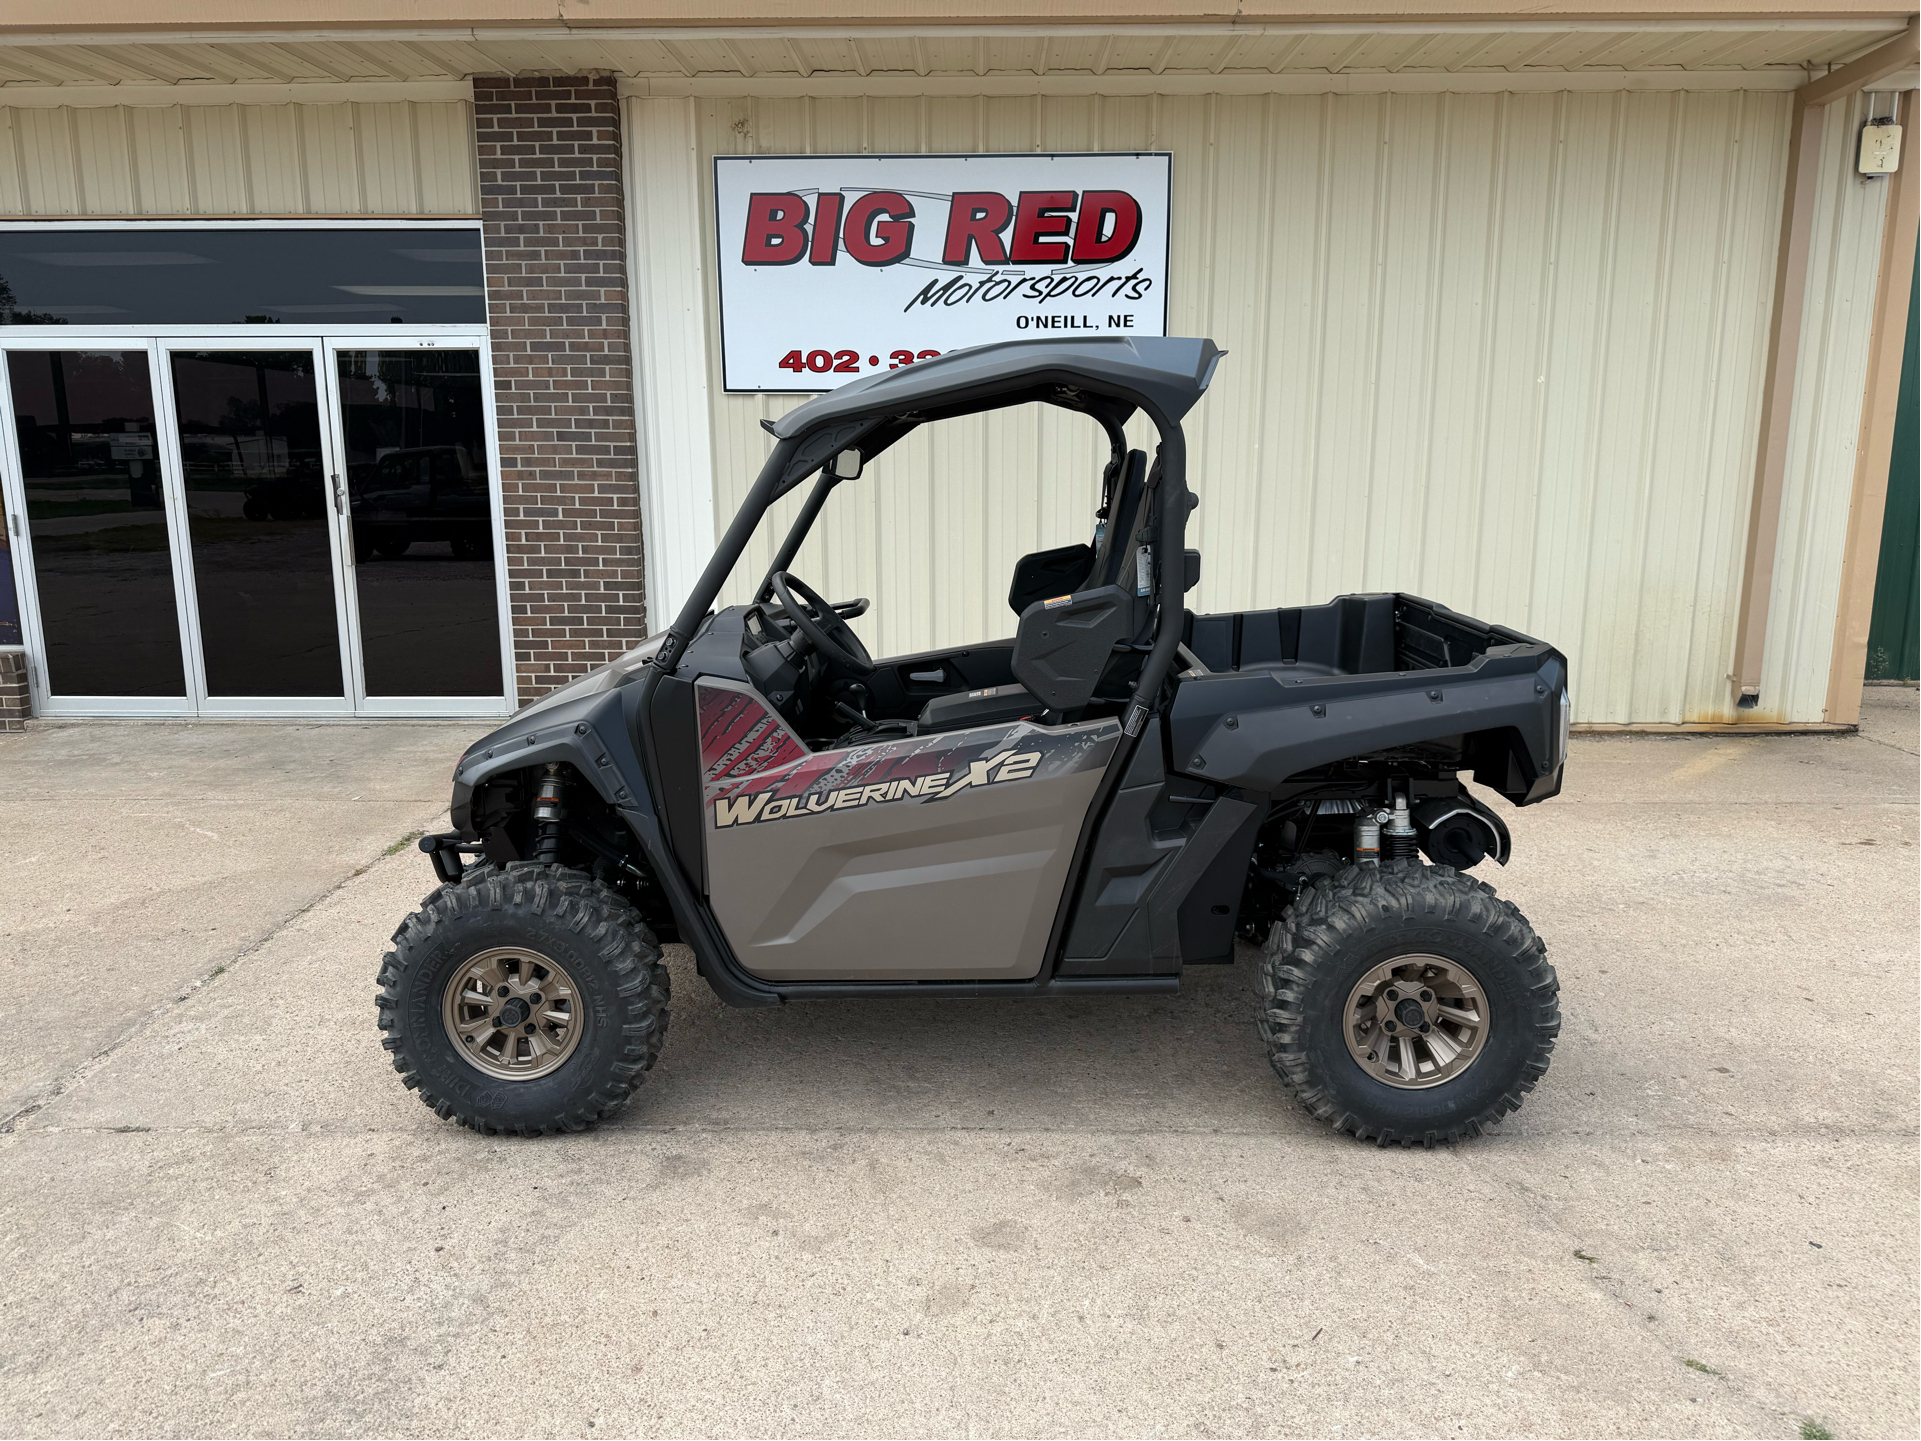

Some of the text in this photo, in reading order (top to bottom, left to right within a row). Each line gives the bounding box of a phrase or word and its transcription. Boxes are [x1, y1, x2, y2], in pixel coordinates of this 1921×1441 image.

[741, 190, 1142, 267] BIG RED
[904, 268, 1153, 313] Motorsports
[1016, 314, 1135, 331] O'NEILL, NE
[778, 349, 860, 373] 402
[922, 750, 1043, 803] X2
